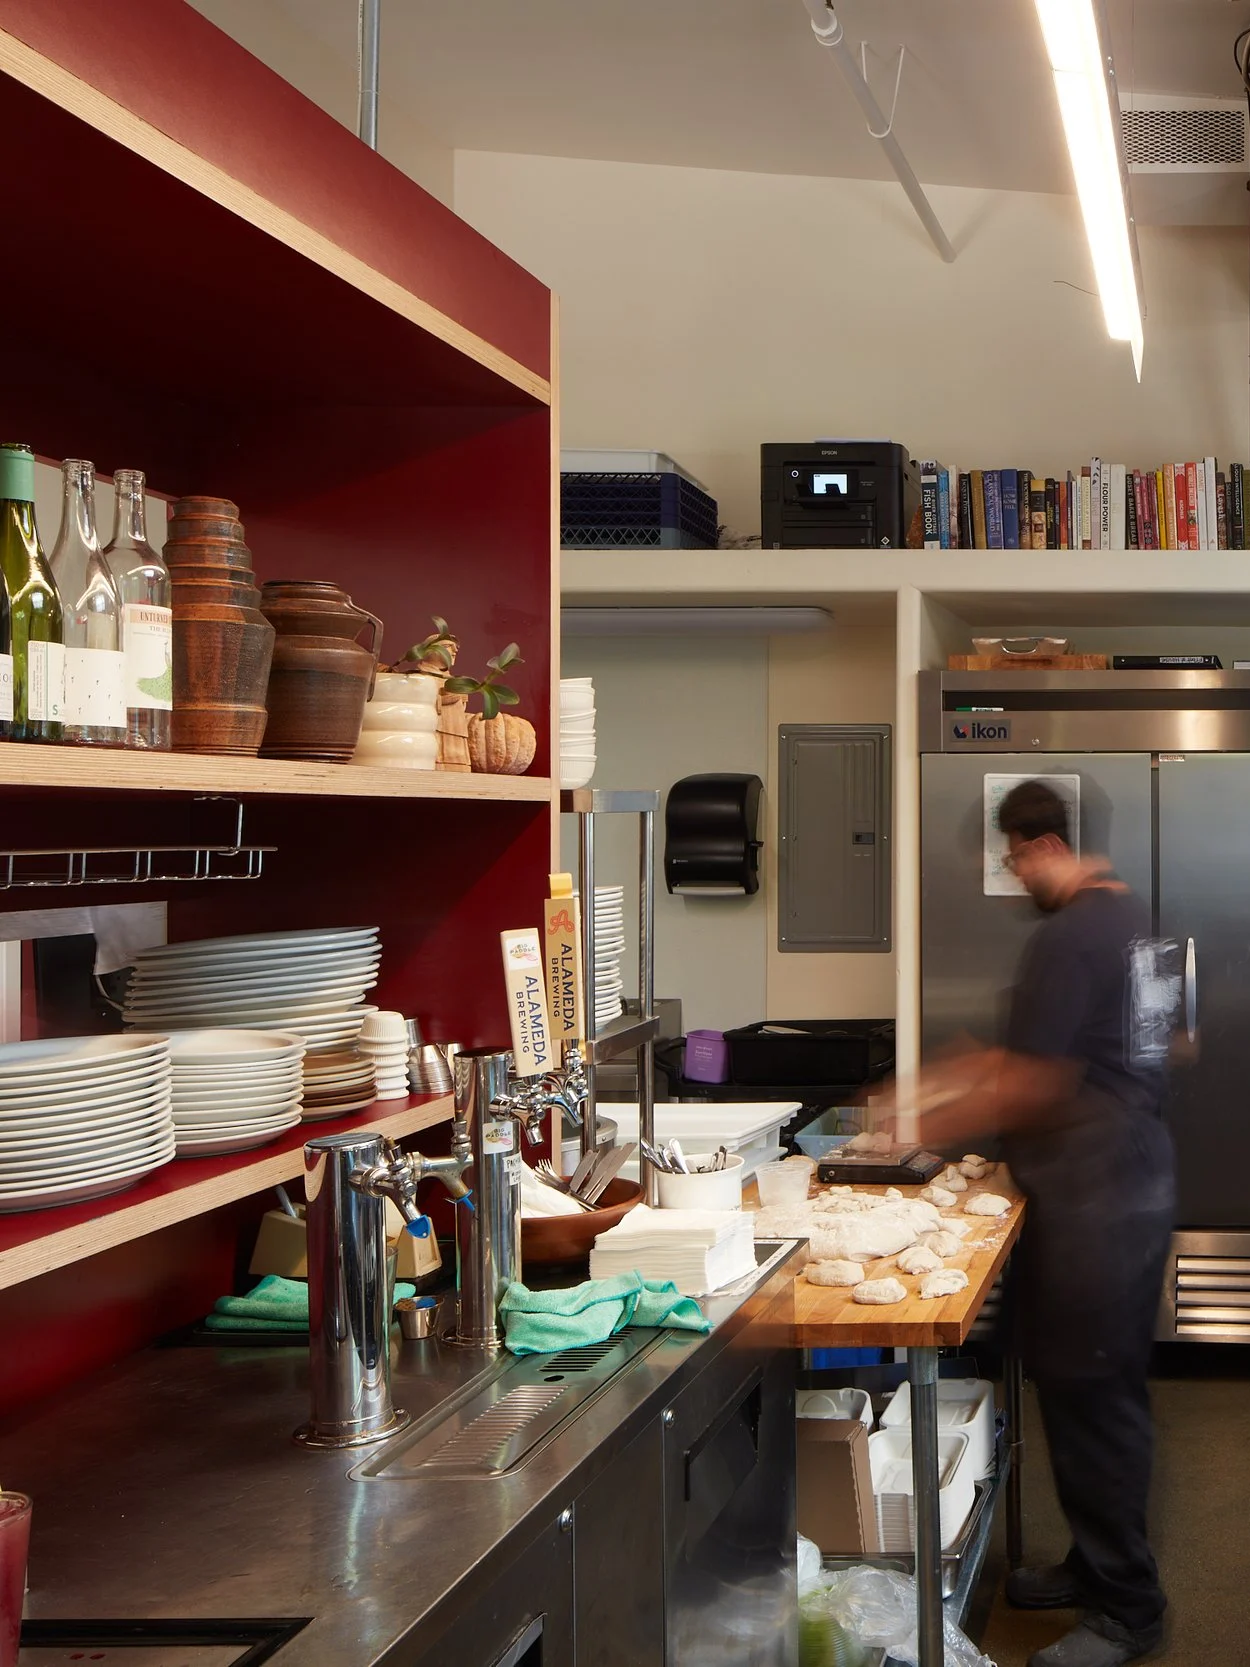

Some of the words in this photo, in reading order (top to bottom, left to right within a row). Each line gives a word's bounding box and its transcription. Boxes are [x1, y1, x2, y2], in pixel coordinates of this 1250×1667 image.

[923, 489, 931, 508] FISH
[1217, 494, 1225, 519] Lavash
[972, 723, 1007, 738] ikon
[552, 958, 560, 1018] BREWING
[561, 943, 574, 1031] ALAMEDA
[516, 992, 529, 1053] BREWING
[525, 976, 546, 1065] ALAMEDA
